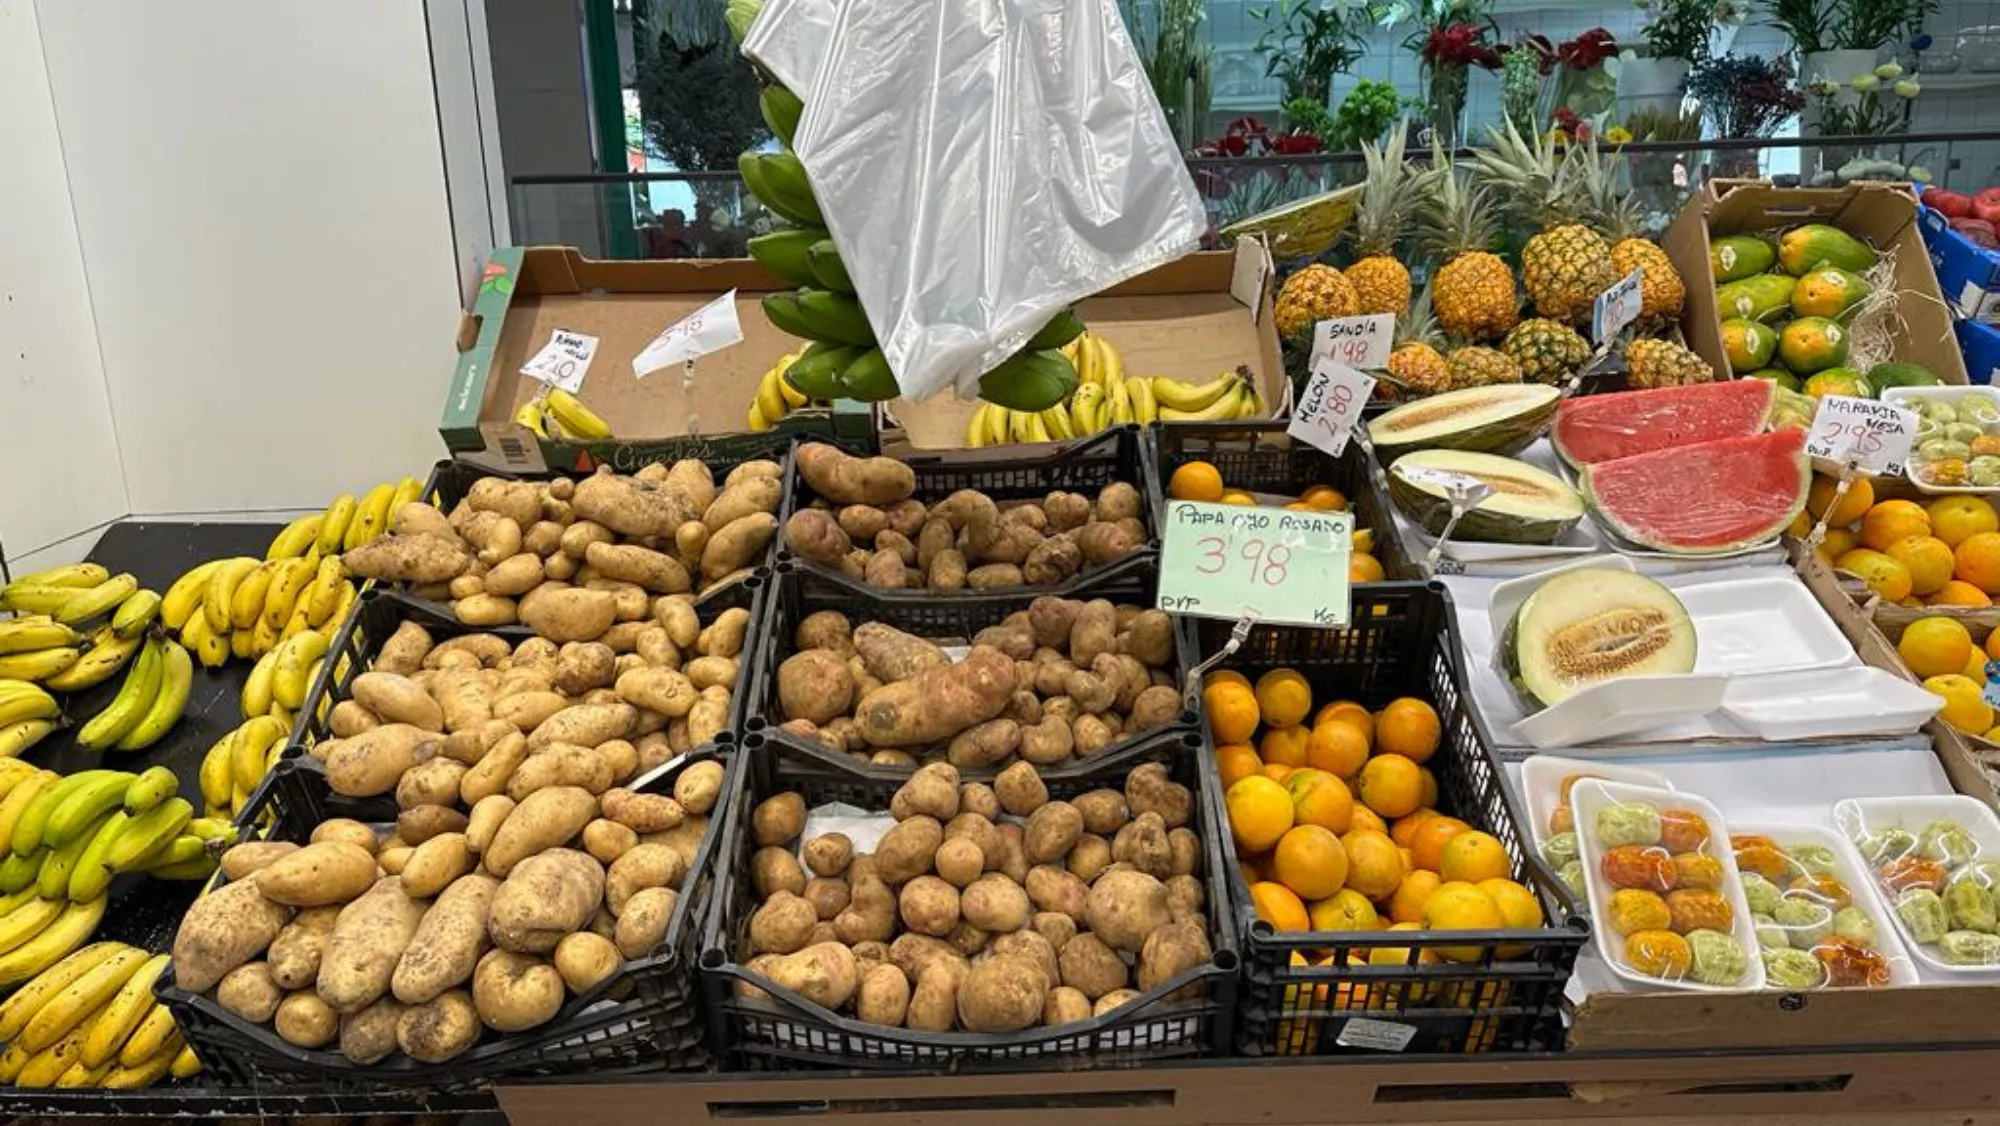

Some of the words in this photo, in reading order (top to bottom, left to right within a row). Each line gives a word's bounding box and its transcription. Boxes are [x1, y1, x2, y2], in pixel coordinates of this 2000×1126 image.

[1176, 504, 1225, 525] PAPA
[1279, 515, 1345, 534] ROSADO
[1196, 535, 1292, 586] 3'98
